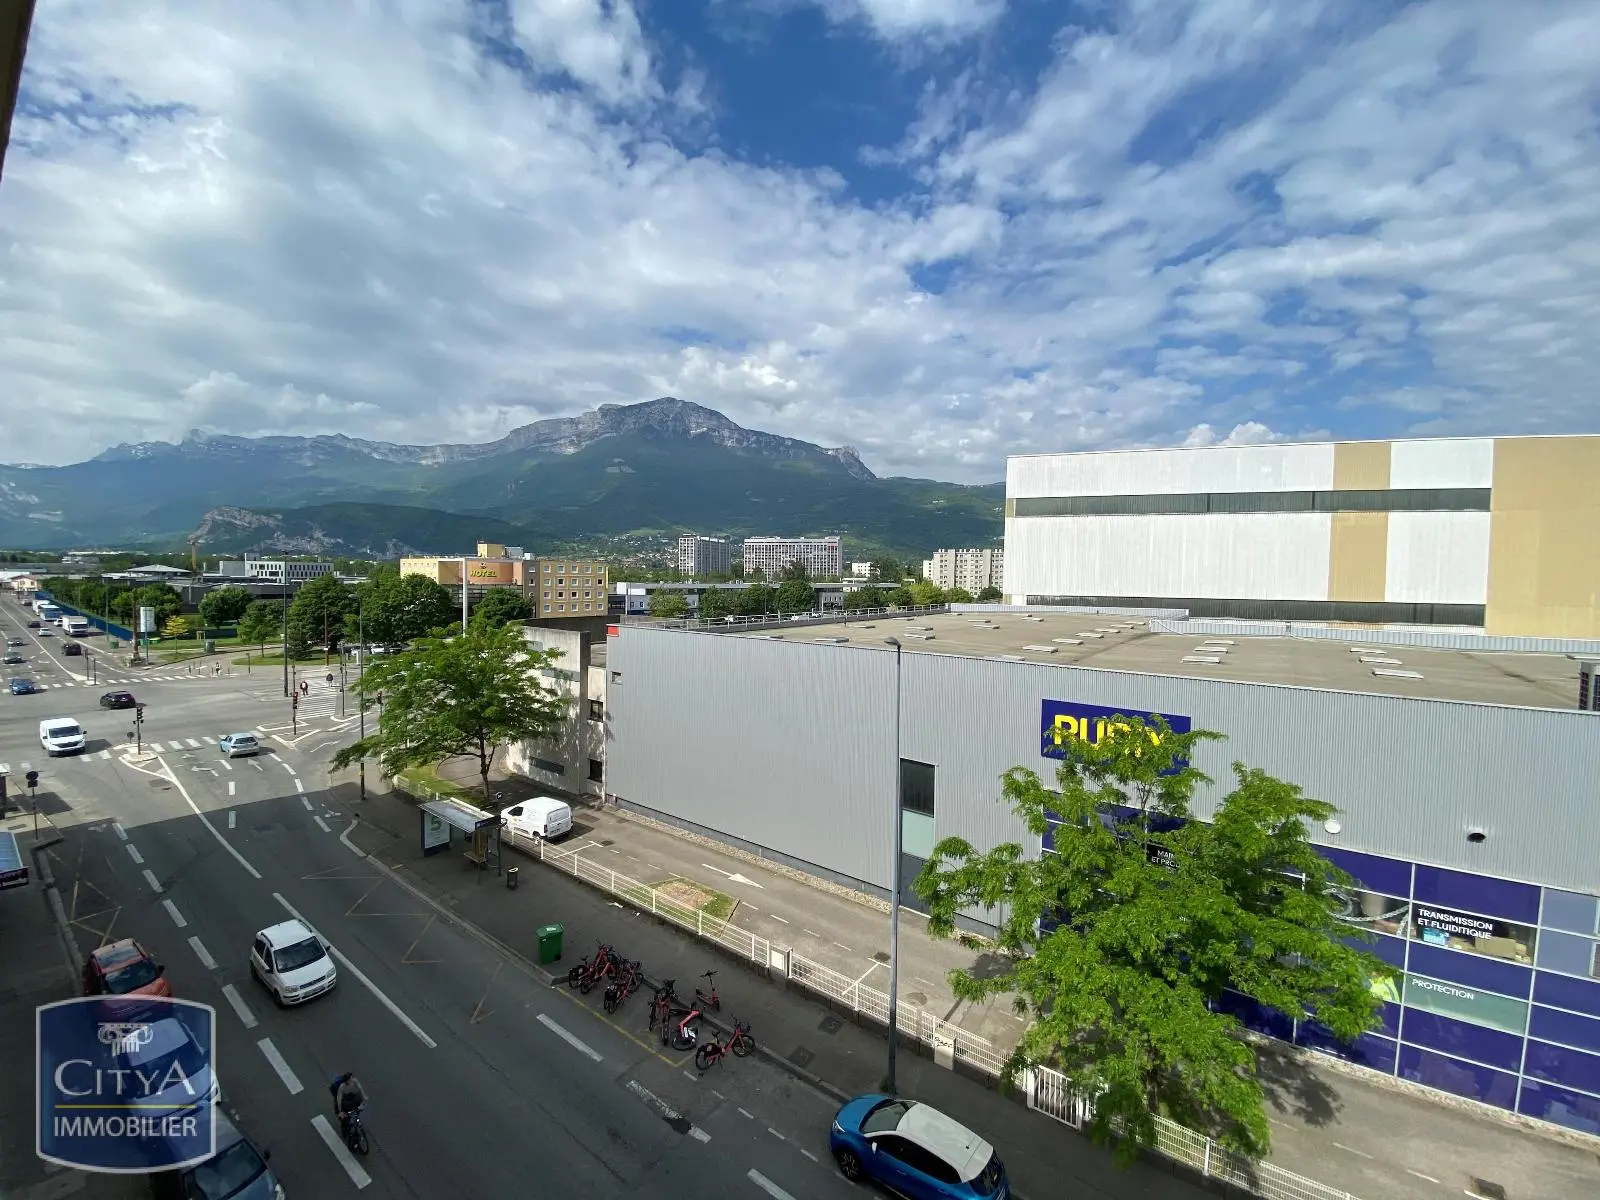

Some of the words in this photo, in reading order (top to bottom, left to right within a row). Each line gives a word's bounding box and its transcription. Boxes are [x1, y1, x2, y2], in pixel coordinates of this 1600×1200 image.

[1151, 856, 1160, 864] ET
[1417, 918, 1430, 926] ET
[1418, 908, 1493, 930] TRANSMISSION
[1412, 979, 1474, 1000] PROTECTION
